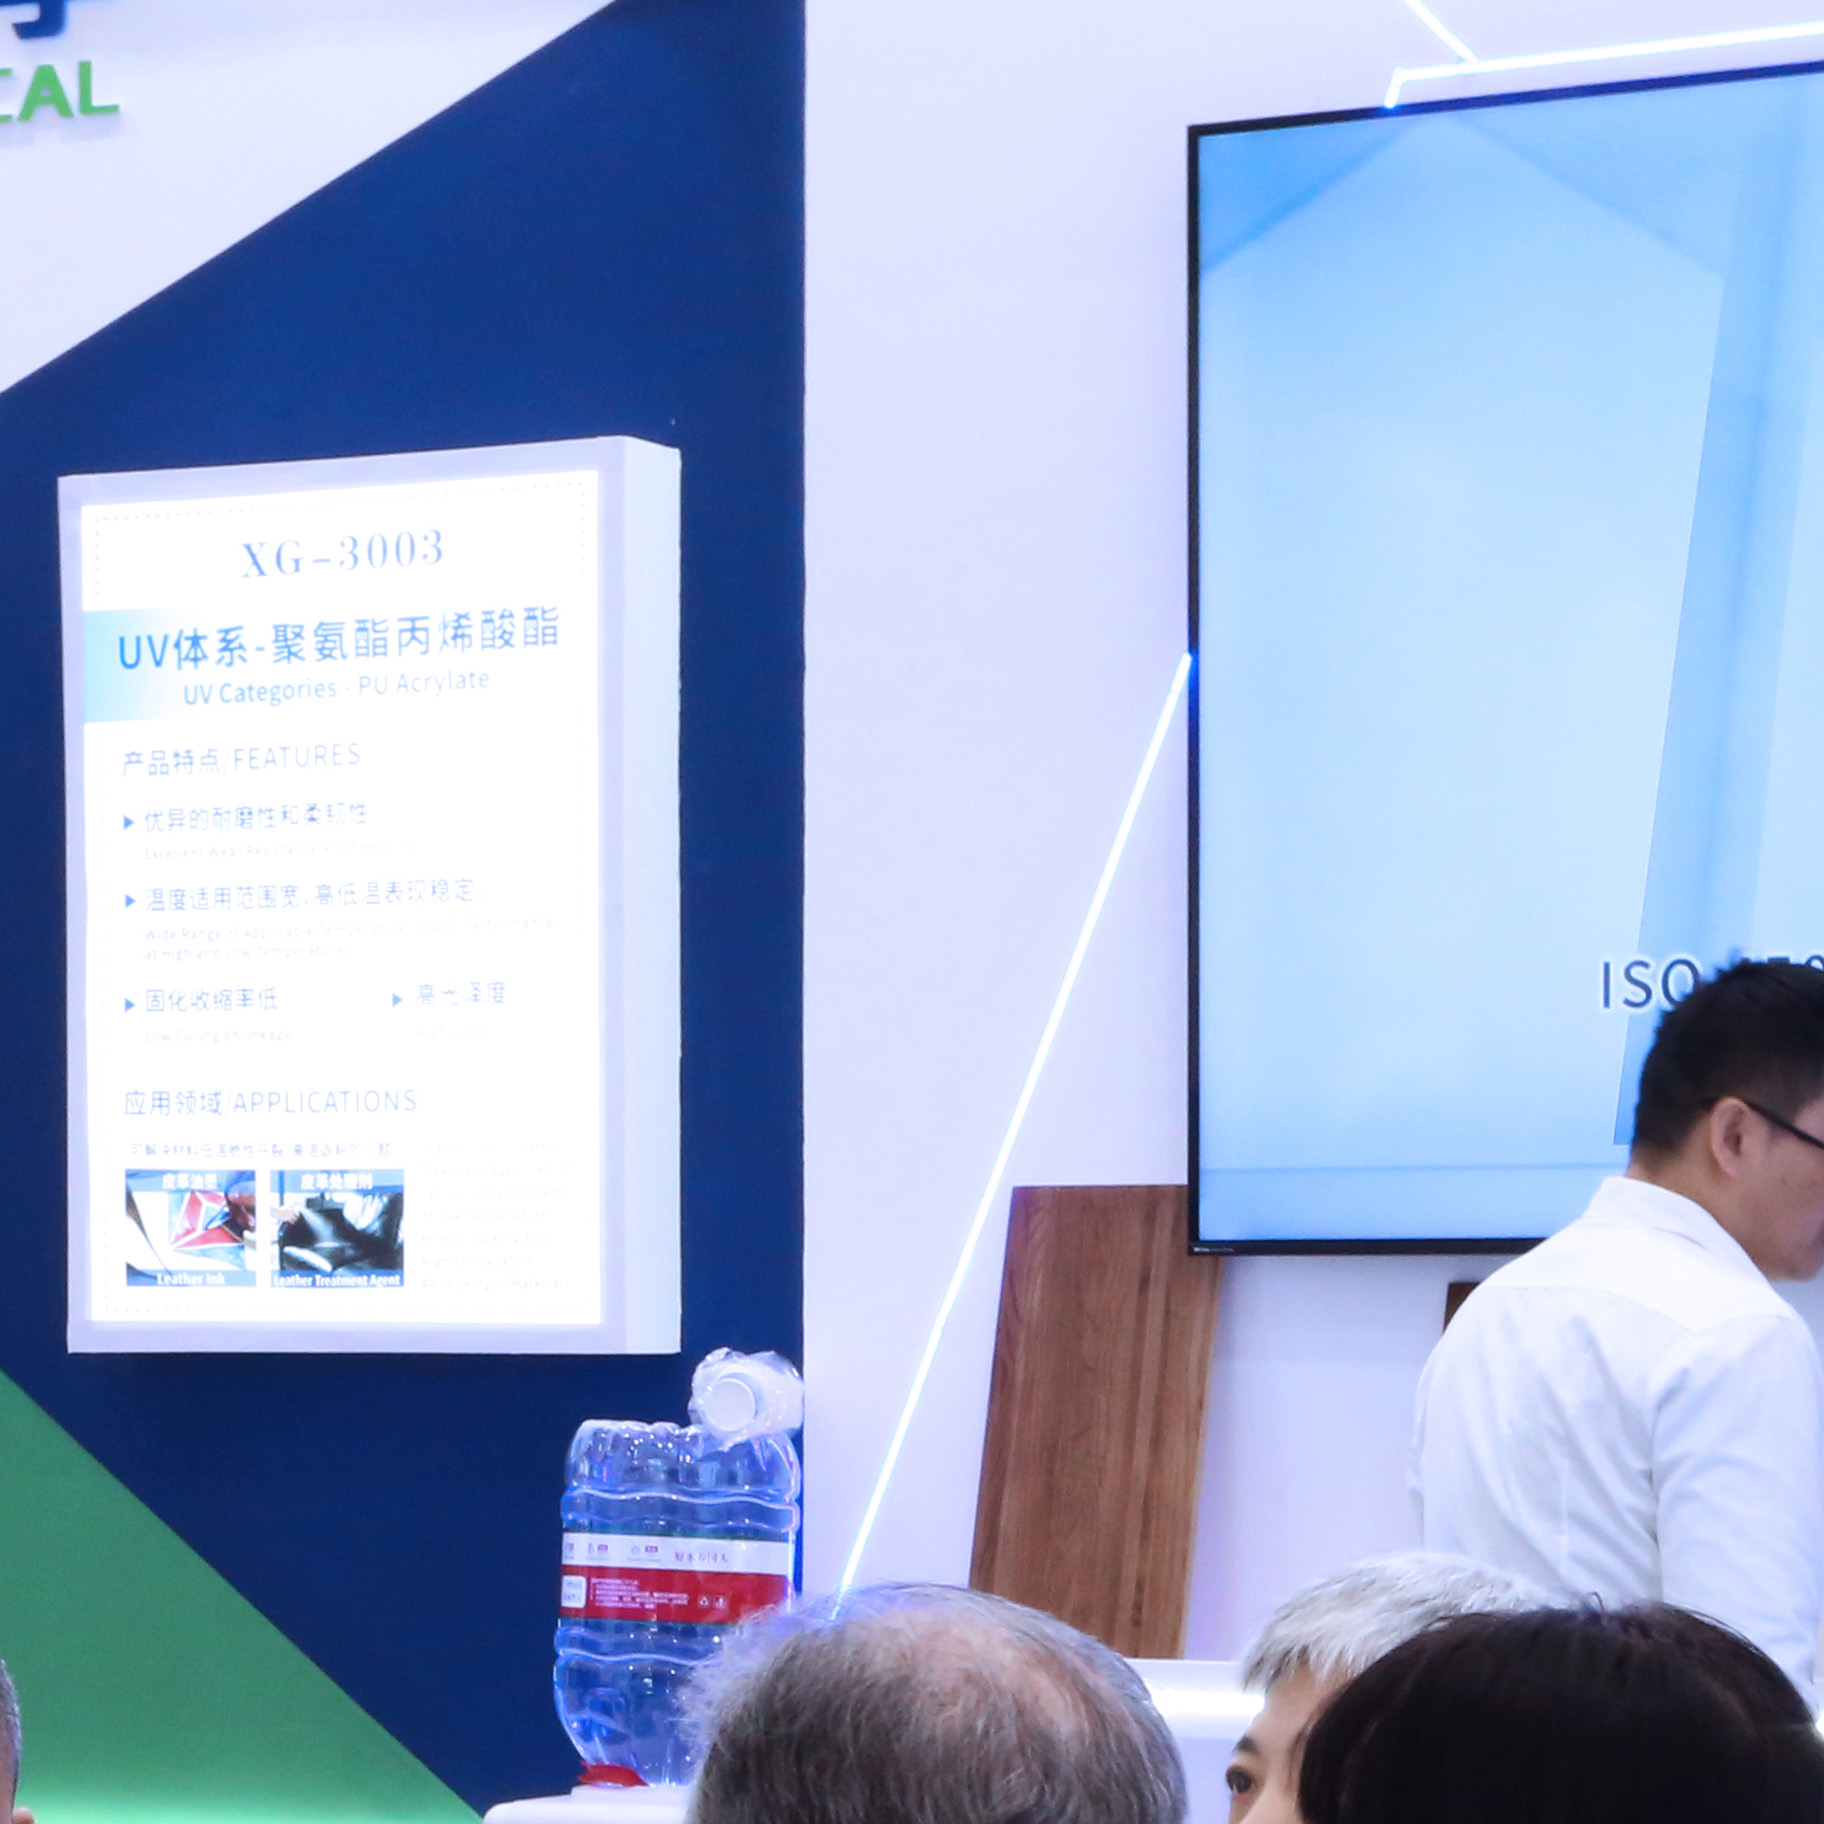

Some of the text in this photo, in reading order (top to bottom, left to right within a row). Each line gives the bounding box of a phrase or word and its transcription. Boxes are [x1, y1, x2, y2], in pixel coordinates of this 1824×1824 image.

[240, 528, 444, 579] XG-3003
[119, 605, 559, 671] UV体系-聚氨酯丙烯酸酯
[184, 684, 213, 706] UV
[219, 678, 337, 707] Categories
[359, 674, 389, 696] PU
[396, 670, 490, 698] Acrylate
[122, 742, 361, 777] 产品特点/FEATURES
[145, 986, 278, 1014] 固化收缩率低
[1602, 957, 1701, 1010] ISO
[123, 1089, 417, 1117] 应用领域/APPLICATIONS
[157, 1272, 226, 1286] Leather Ink
[275, 1273, 401, 1289] Leather Treatment Agent
